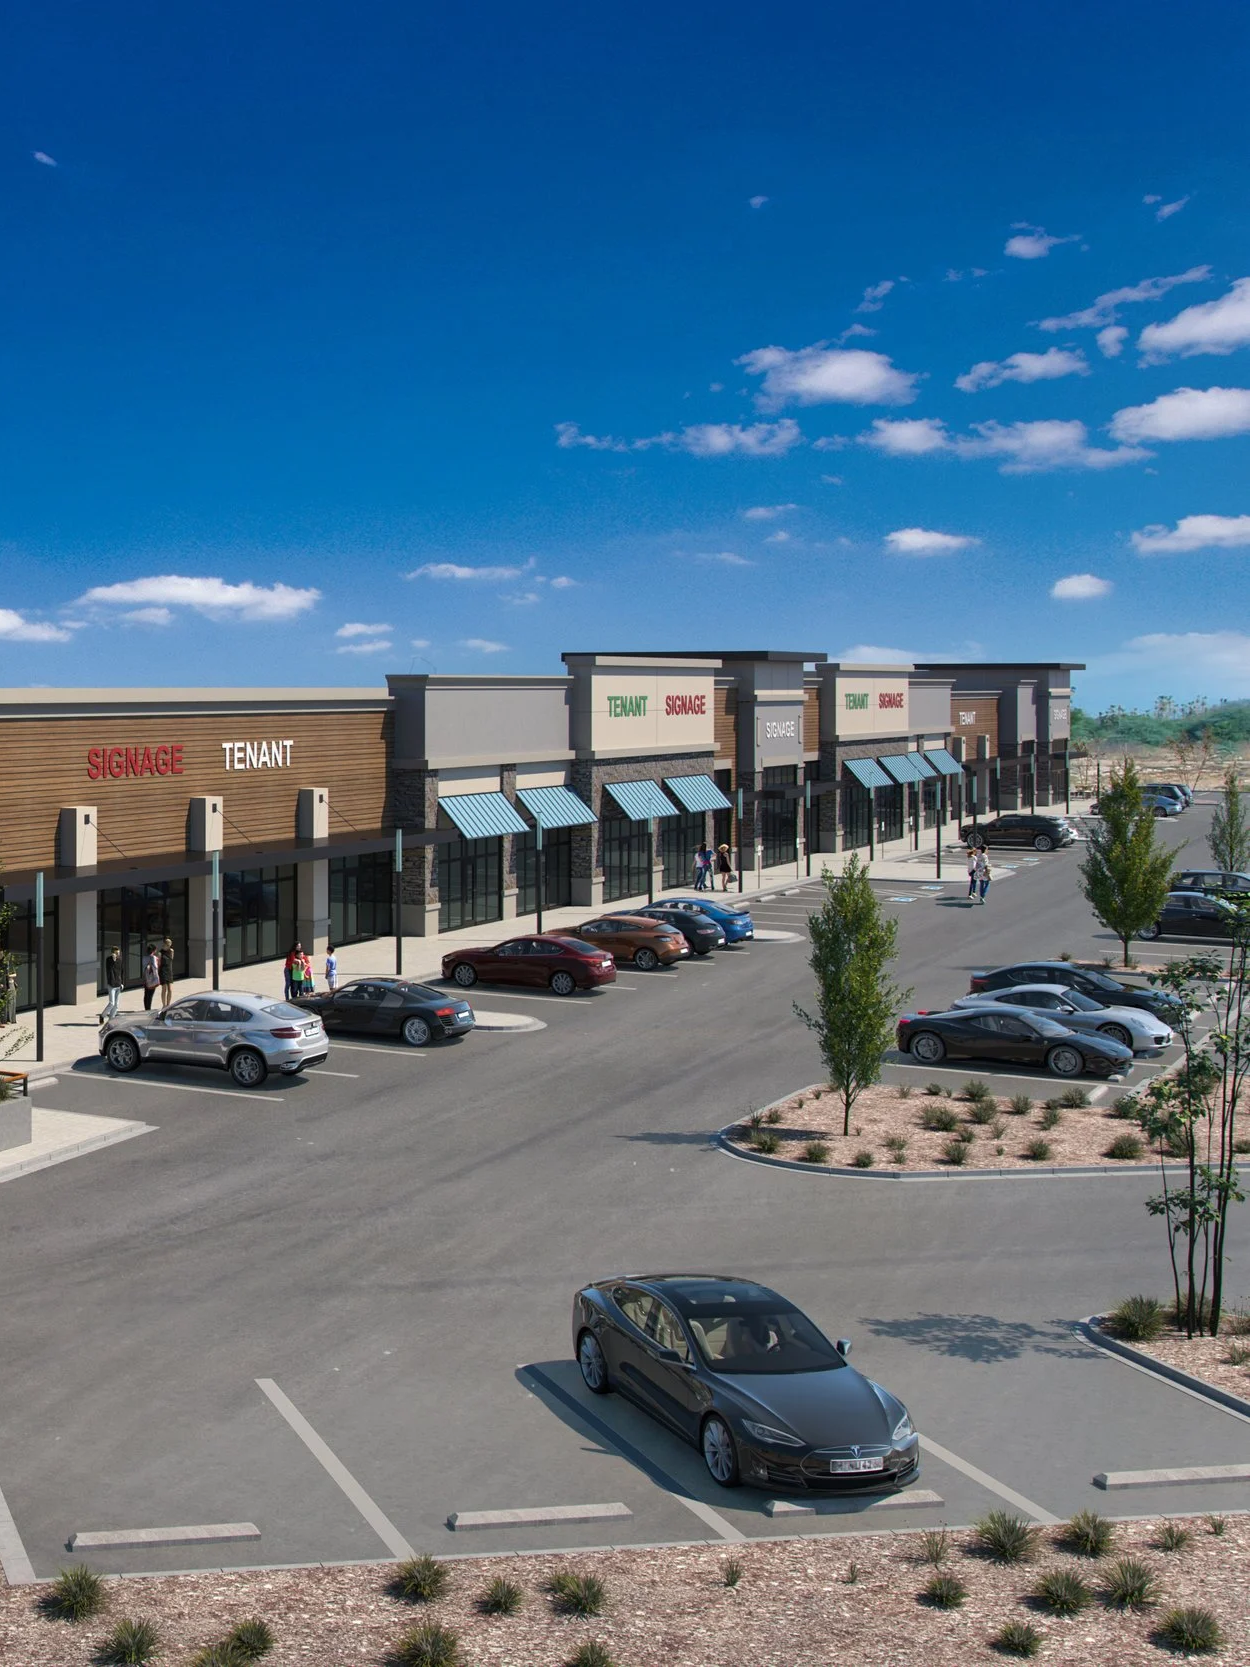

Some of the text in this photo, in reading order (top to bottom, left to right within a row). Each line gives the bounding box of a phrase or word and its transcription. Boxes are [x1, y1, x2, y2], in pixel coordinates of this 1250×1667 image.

[607, 694, 706, 717] TENANT SIGNAGE
[844, 692, 904, 710] TENANT SIGNAGE
[765, 721, 795, 738] SIGNAGE
[87, 740, 293, 779] SIGNAGE TENANT
